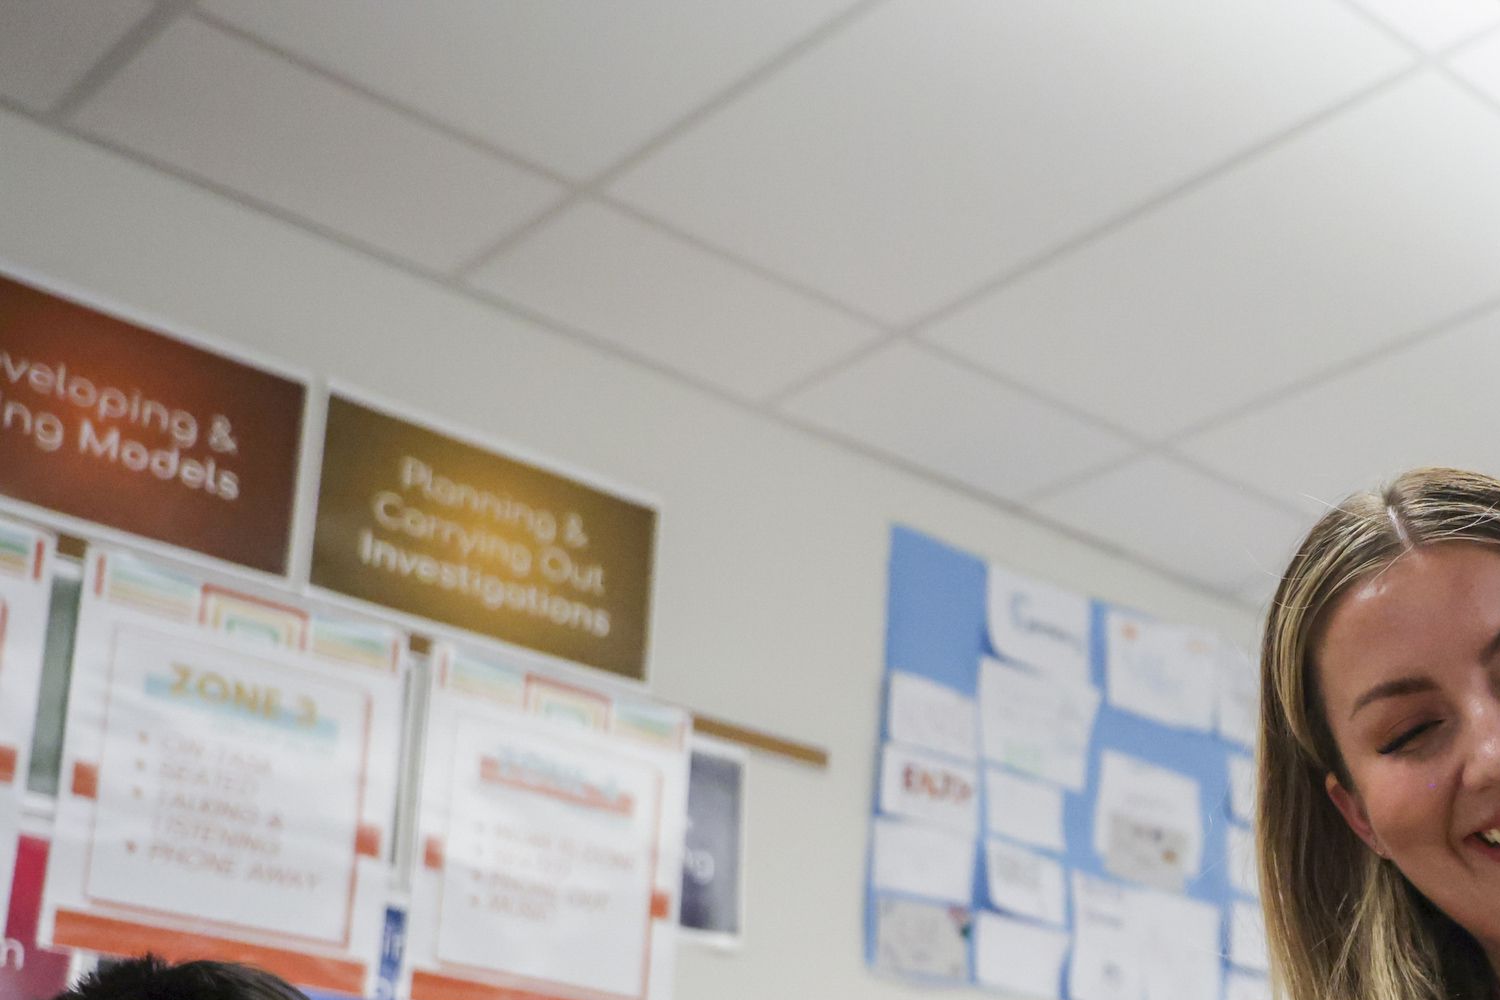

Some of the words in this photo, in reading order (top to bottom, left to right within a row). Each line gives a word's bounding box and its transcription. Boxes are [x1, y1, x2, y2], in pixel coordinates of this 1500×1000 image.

[0, 351, 198, 449] veloping
[208, 413, 240, 455] &
[2, 401, 64, 451] ng
[79, 417, 240, 500] Models
[373, 489, 533, 578] Carrying
[539, 546, 605, 596] Out
[400, 455, 556, 544] Planning
[564, 512, 588, 548] &
[359, 528, 611, 639] Investigations
[168, 661, 281, 720] ZONE
